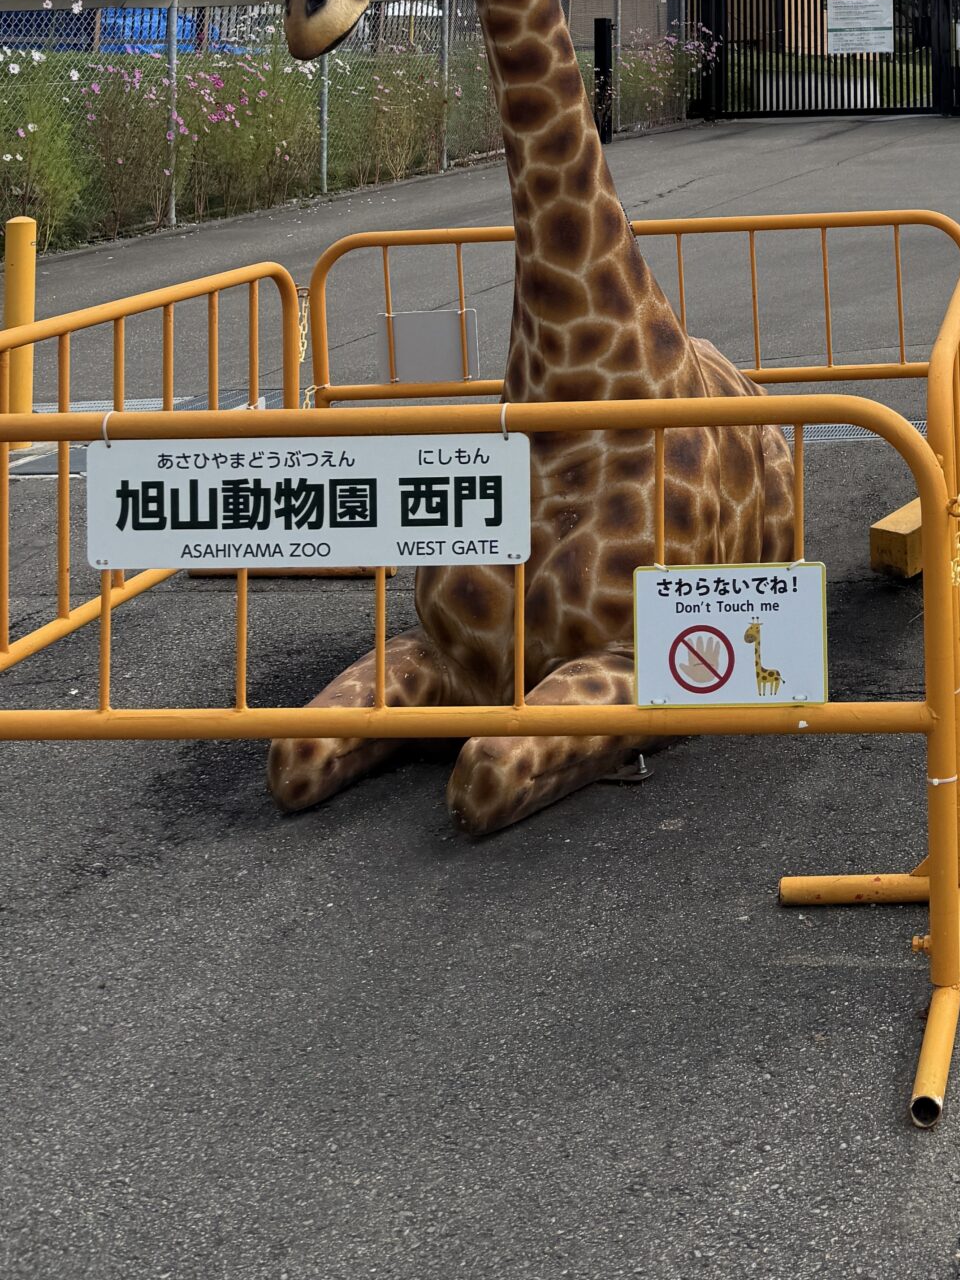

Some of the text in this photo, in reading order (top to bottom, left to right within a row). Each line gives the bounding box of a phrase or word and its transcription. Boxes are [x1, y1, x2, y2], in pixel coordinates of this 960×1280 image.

[157, 447, 491, 470] あさひやまどうぶつえん にしもん
[115, 475, 503, 533] 旭山動物園 西門
[180, 539, 500, 559] ASAHIYAMA ZOO WEST GATE
[675, 600, 780, 614] Don't Touch me
